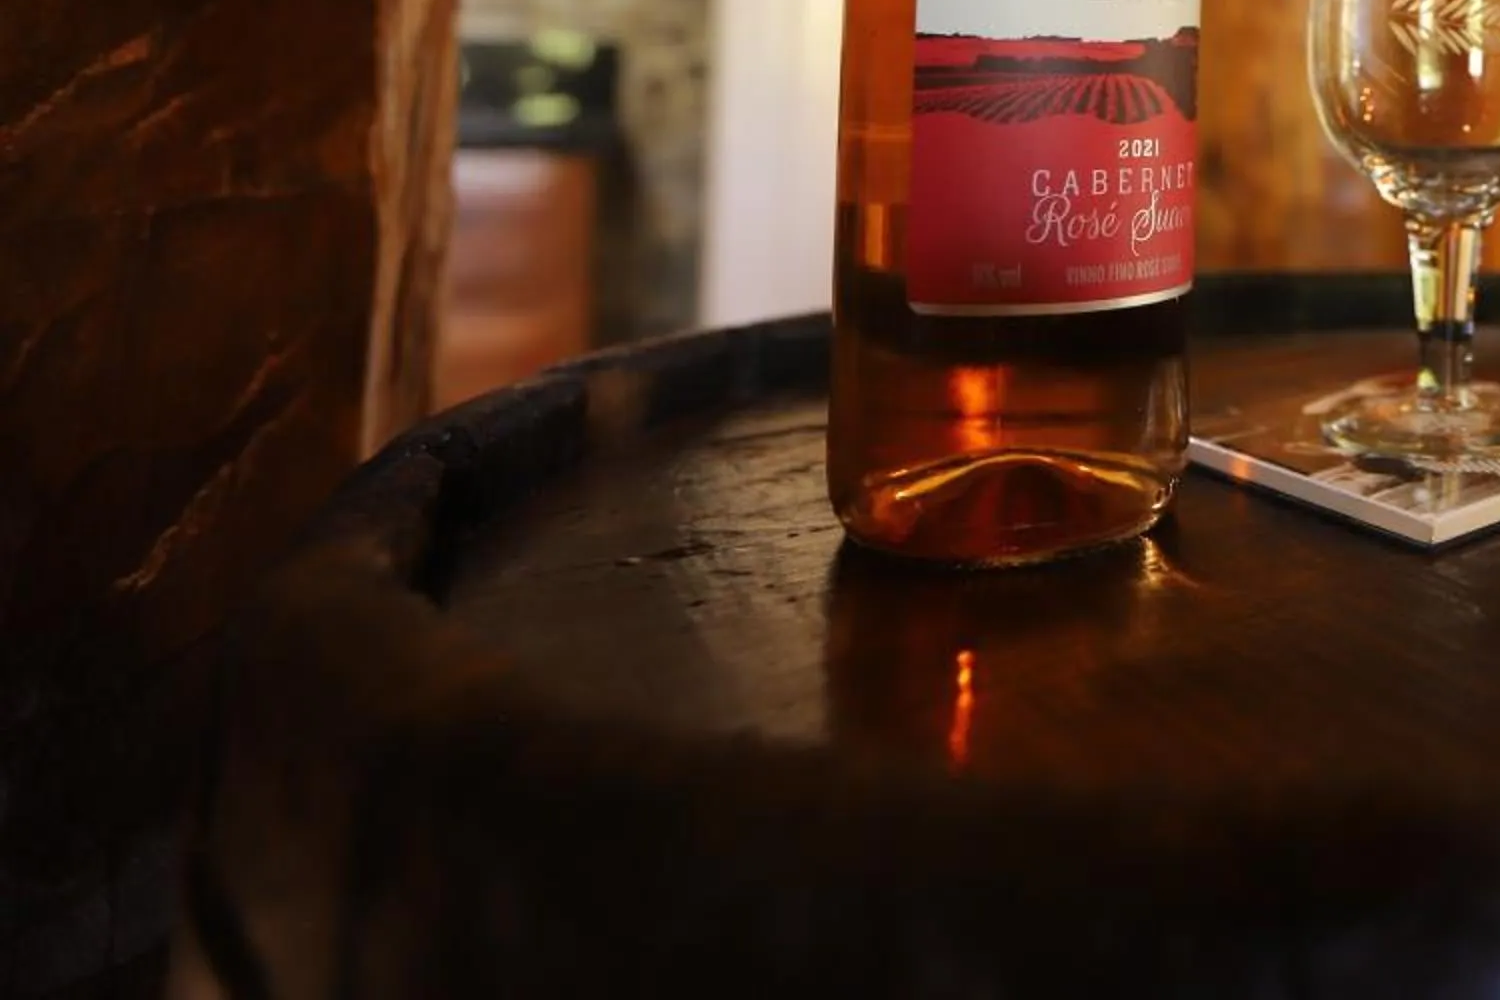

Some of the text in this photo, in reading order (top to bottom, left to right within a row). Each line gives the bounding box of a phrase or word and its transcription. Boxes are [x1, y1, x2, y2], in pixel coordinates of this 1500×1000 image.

[1118, 137, 1160, 158] 2021
[1031, 161, 1193, 197] CABERNET
[1025, 193, 1122, 247] Rosé
